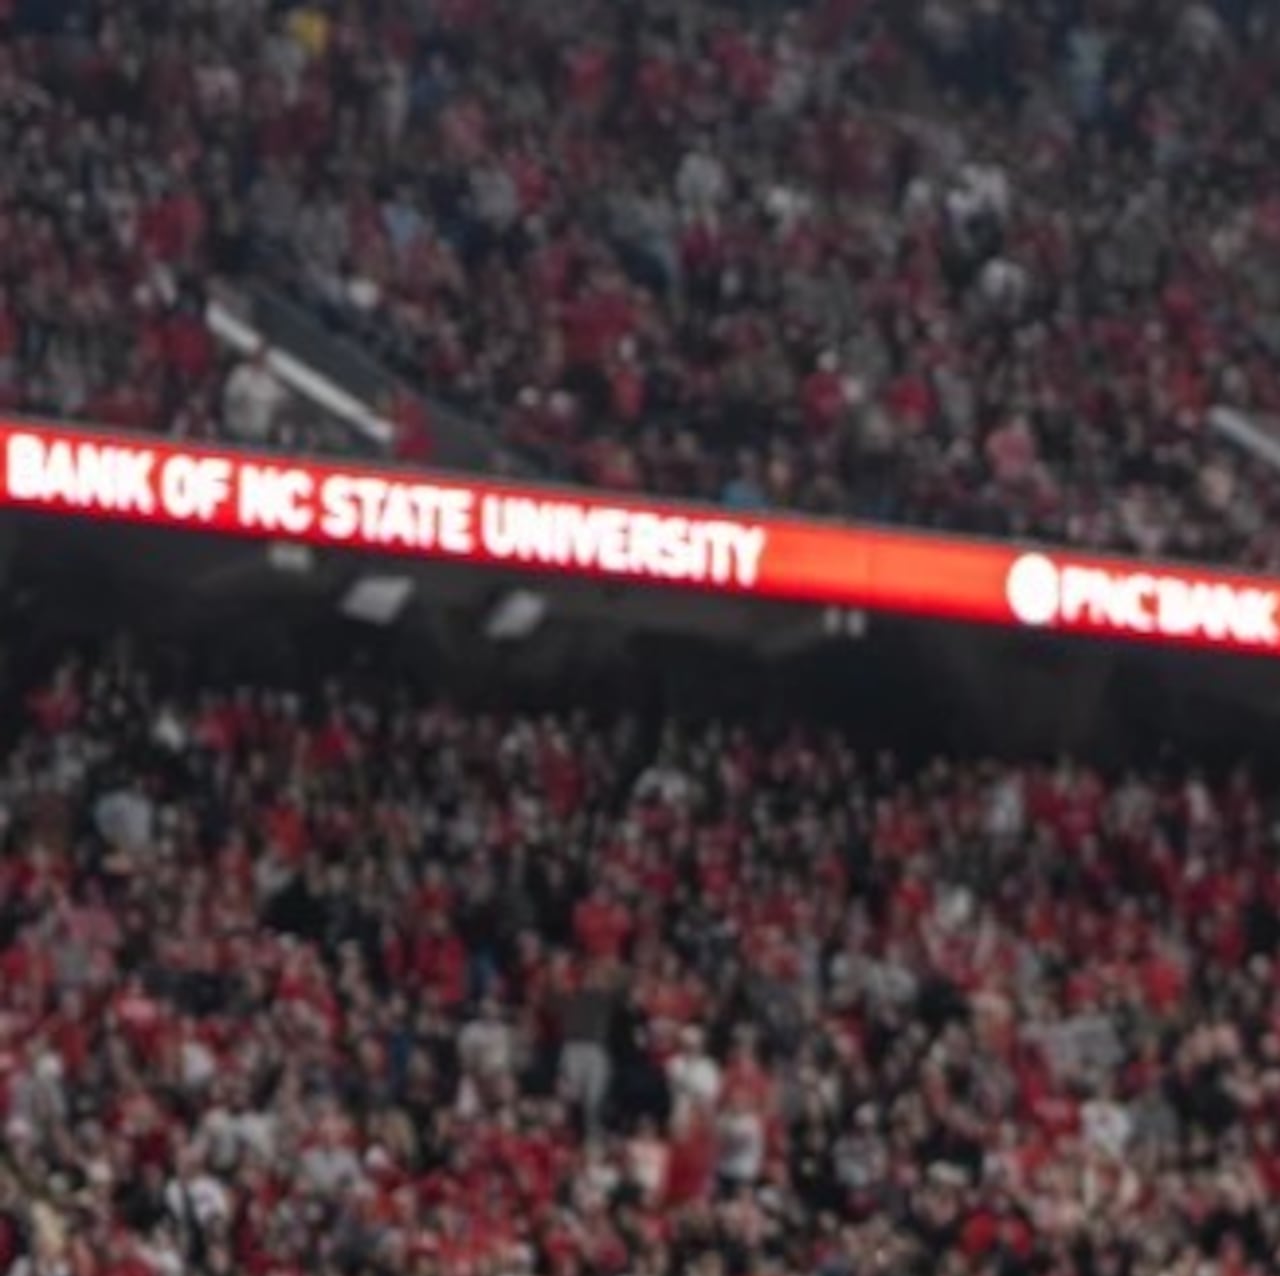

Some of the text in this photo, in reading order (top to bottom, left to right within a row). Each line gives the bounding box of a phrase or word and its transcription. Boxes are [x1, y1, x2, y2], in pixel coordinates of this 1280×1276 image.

[5, 433, 765, 586] BANK OF NC STATE UNIVERSITY
